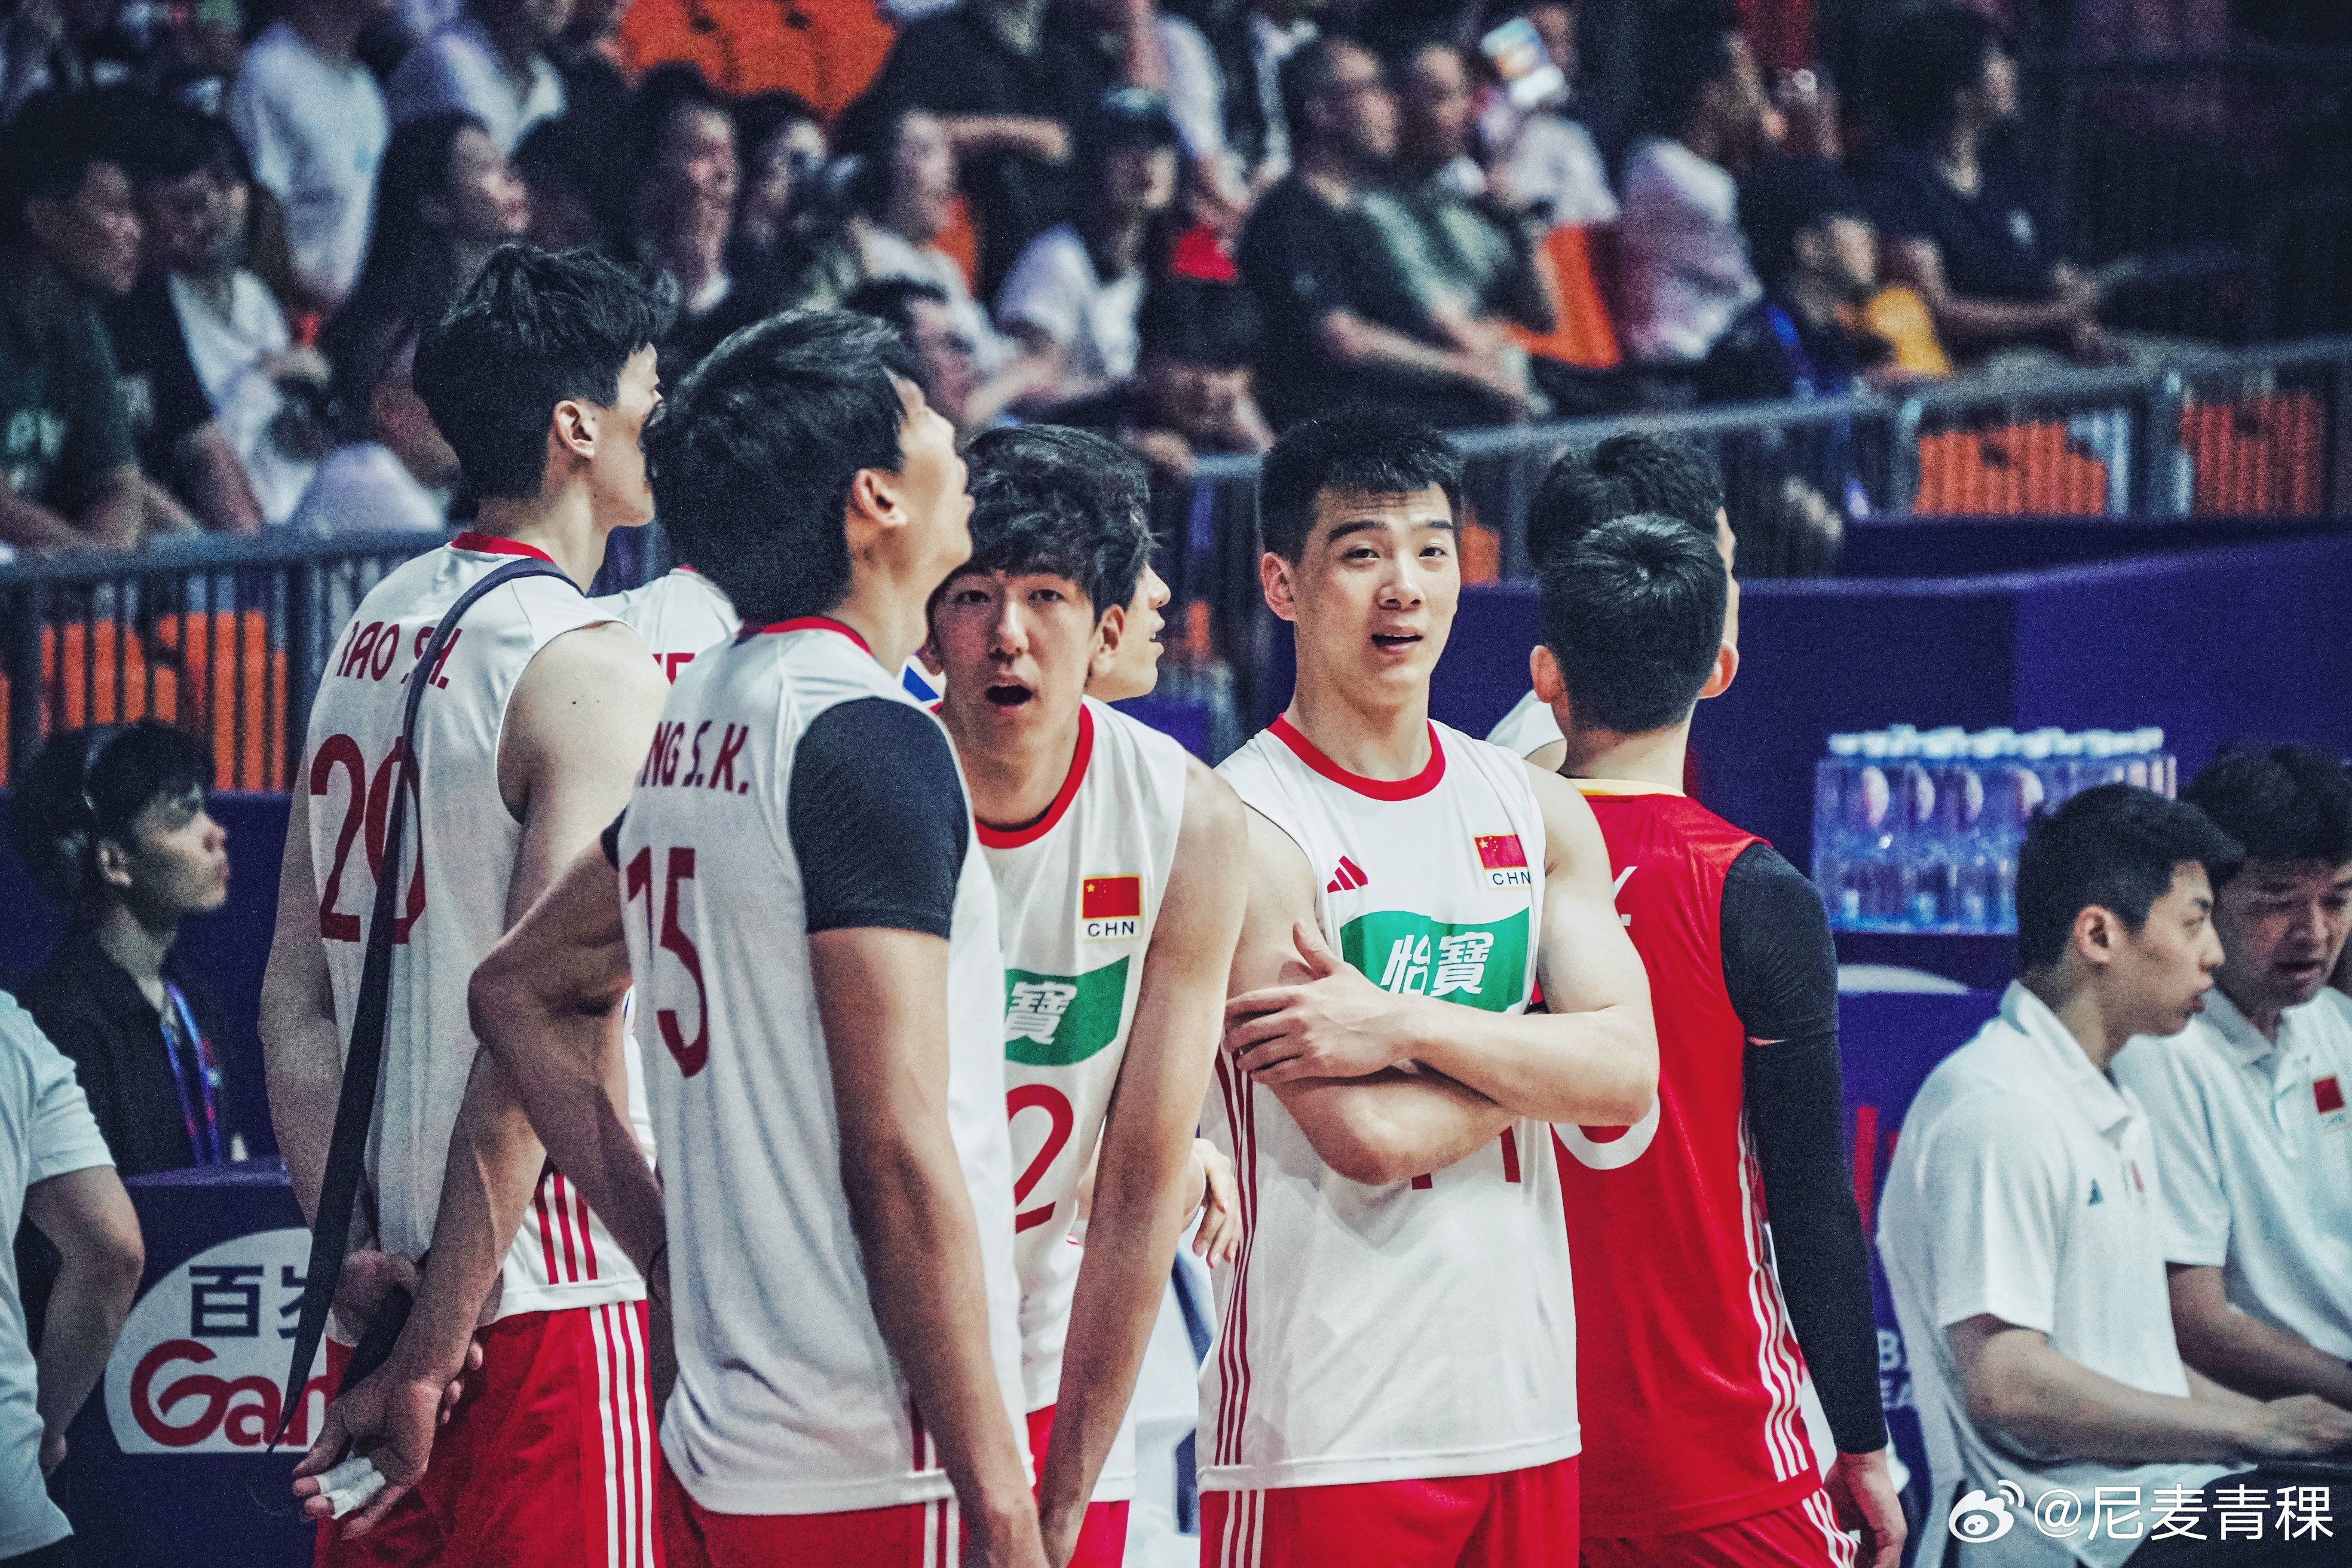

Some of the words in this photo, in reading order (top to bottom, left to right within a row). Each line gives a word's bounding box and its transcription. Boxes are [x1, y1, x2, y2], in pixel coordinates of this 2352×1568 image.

[310, 733, 426, 945] 20
[1492, 871, 1531, 886] CHN
[626, 846, 709, 1077] 15
[1087, 920, 1135, 938] CHN
